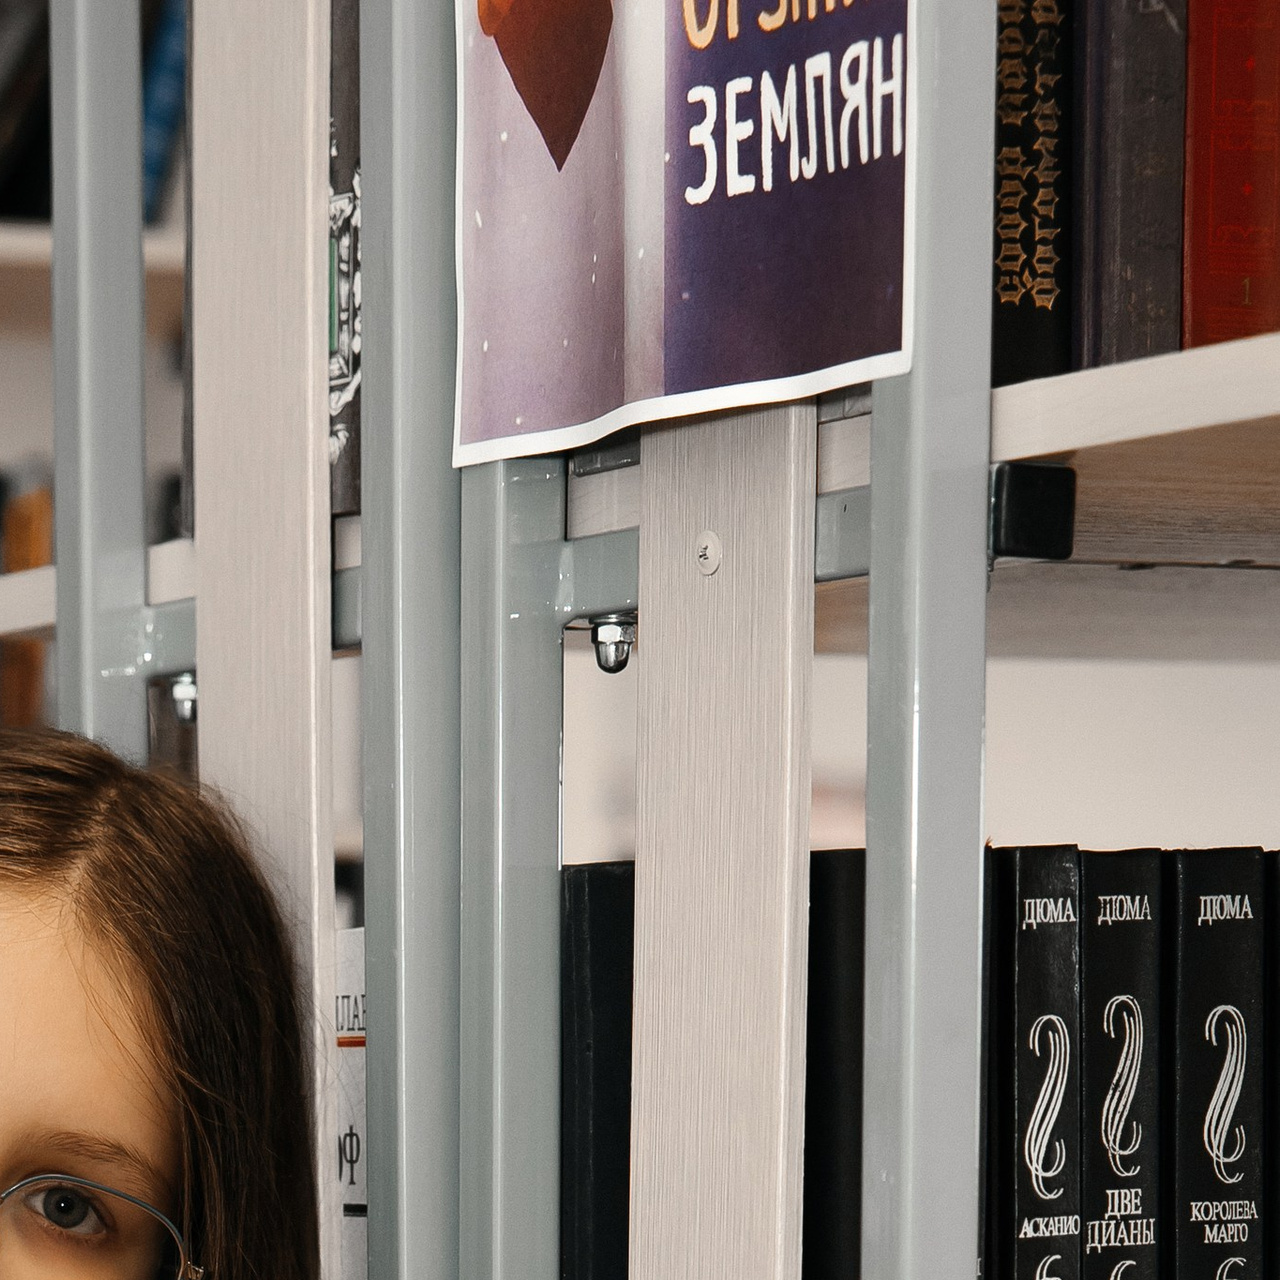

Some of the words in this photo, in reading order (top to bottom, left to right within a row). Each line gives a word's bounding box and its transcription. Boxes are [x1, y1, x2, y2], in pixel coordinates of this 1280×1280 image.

[684, 33, 904, 206] ЗЕМЛЯН
[1023, 898, 1077, 929] ДЮМА
[1097, 895, 1152, 925] ДЮМА
[1198, 895, 1253, 926] ДЮМА
[1105, 1188, 1142, 1219] ДВЕ
[1190, 1200, 1258, 1222] КОРОЛЕВА
[1019, 1215, 1081, 1239] АСКАНИО
[1086, 1218, 1156, 1254] ДИАНЫ
[1204, 1223, 1248, 1243] МАРГО
